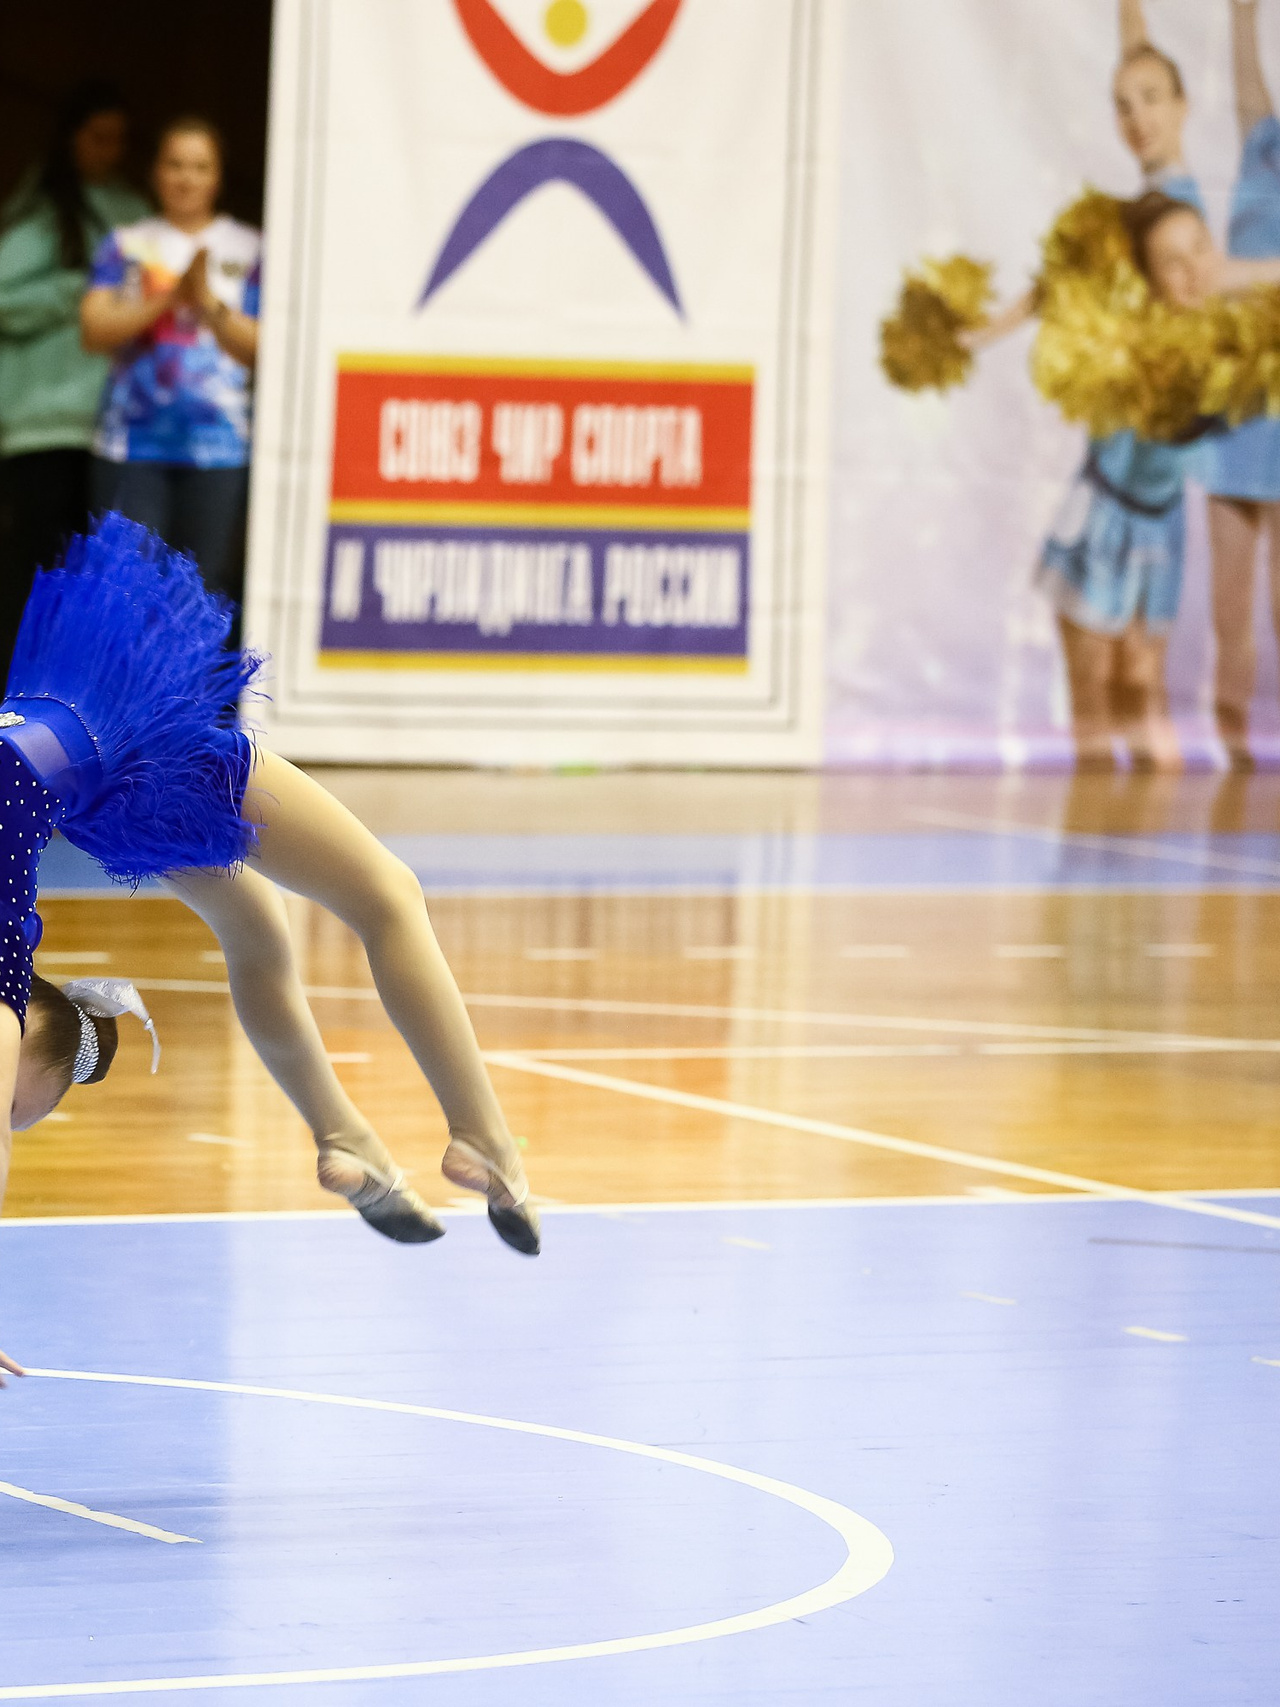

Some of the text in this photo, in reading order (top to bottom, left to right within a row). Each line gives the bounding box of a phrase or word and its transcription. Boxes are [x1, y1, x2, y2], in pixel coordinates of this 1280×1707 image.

[379, 400, 702, 487] СОЮЗ ЧИР СПОРТА
[330, 540, 365, 621] И
[603, 545, 739, 628] РОССИИ
